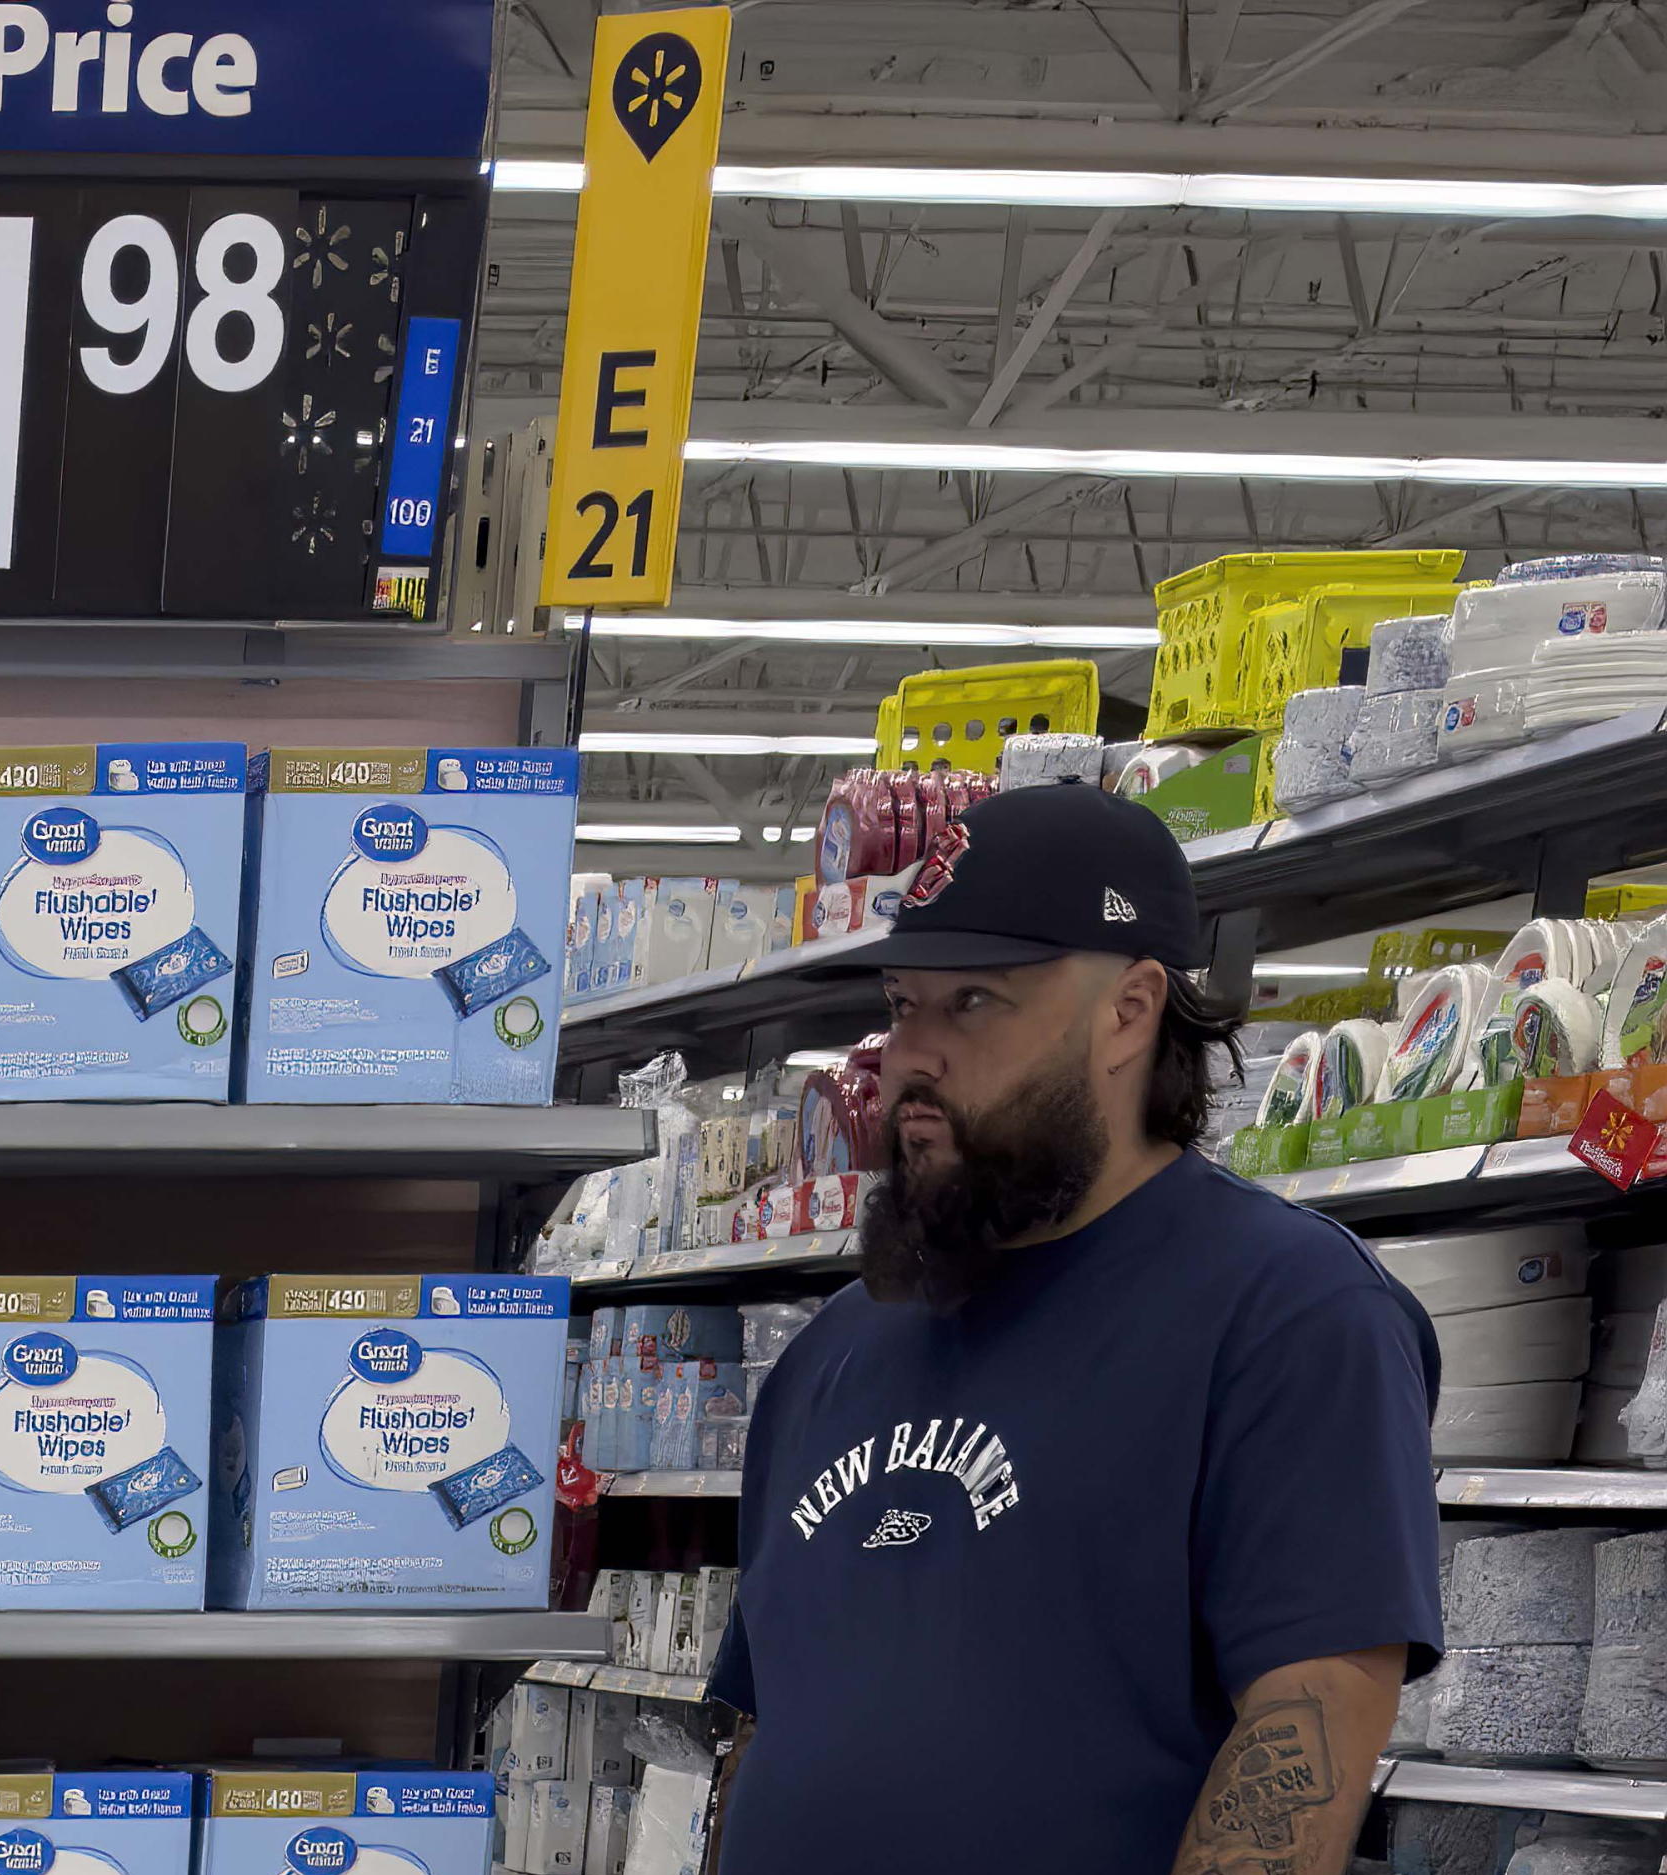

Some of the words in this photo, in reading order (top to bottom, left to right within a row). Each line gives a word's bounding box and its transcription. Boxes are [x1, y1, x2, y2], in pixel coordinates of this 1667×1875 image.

[424, 348, 441, 375] E
[591, 349, 657, 449] E
[410, 417, 435, 443] 21
[389, 498, 432, 526] 100
[571, 489, 654, 580] 21
[60, 916, 131, 943] Wipes
[386, 914, 455, 940] Wipes
[37, 1435, 106, 1460] Wipes
[381, 1432, 450, 1457] Wipes
[790, 1436, 877, 1541] NEW
[884, 1417, 1020, 1532] BALANCE
